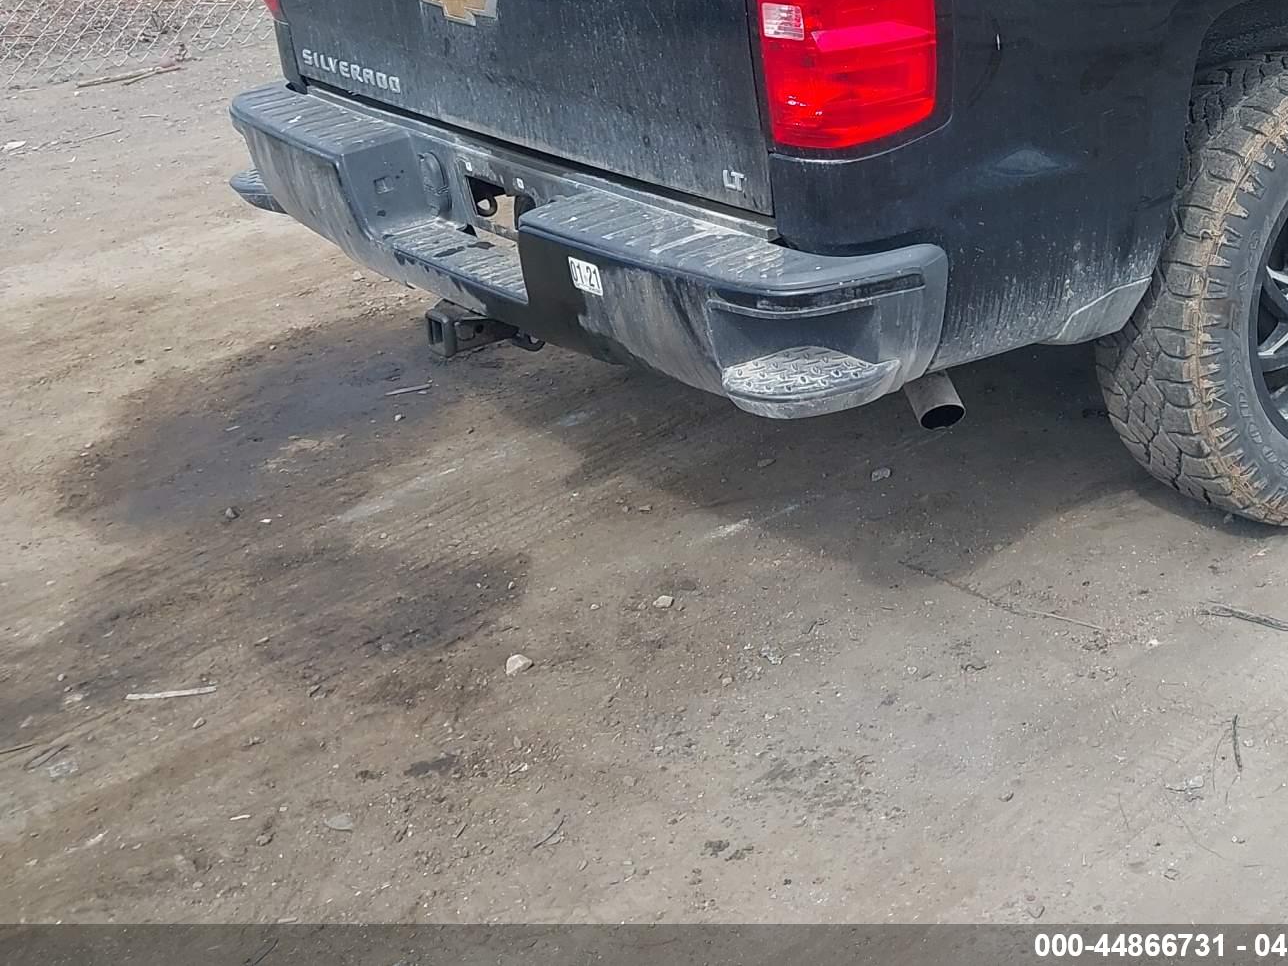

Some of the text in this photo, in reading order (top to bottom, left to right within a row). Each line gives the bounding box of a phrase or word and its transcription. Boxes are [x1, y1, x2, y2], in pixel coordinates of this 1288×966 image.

[302, 48, 401, 94] SILVERADO
[722, 169, 745, 192] LT
[586, 265, 601, 290] 21
